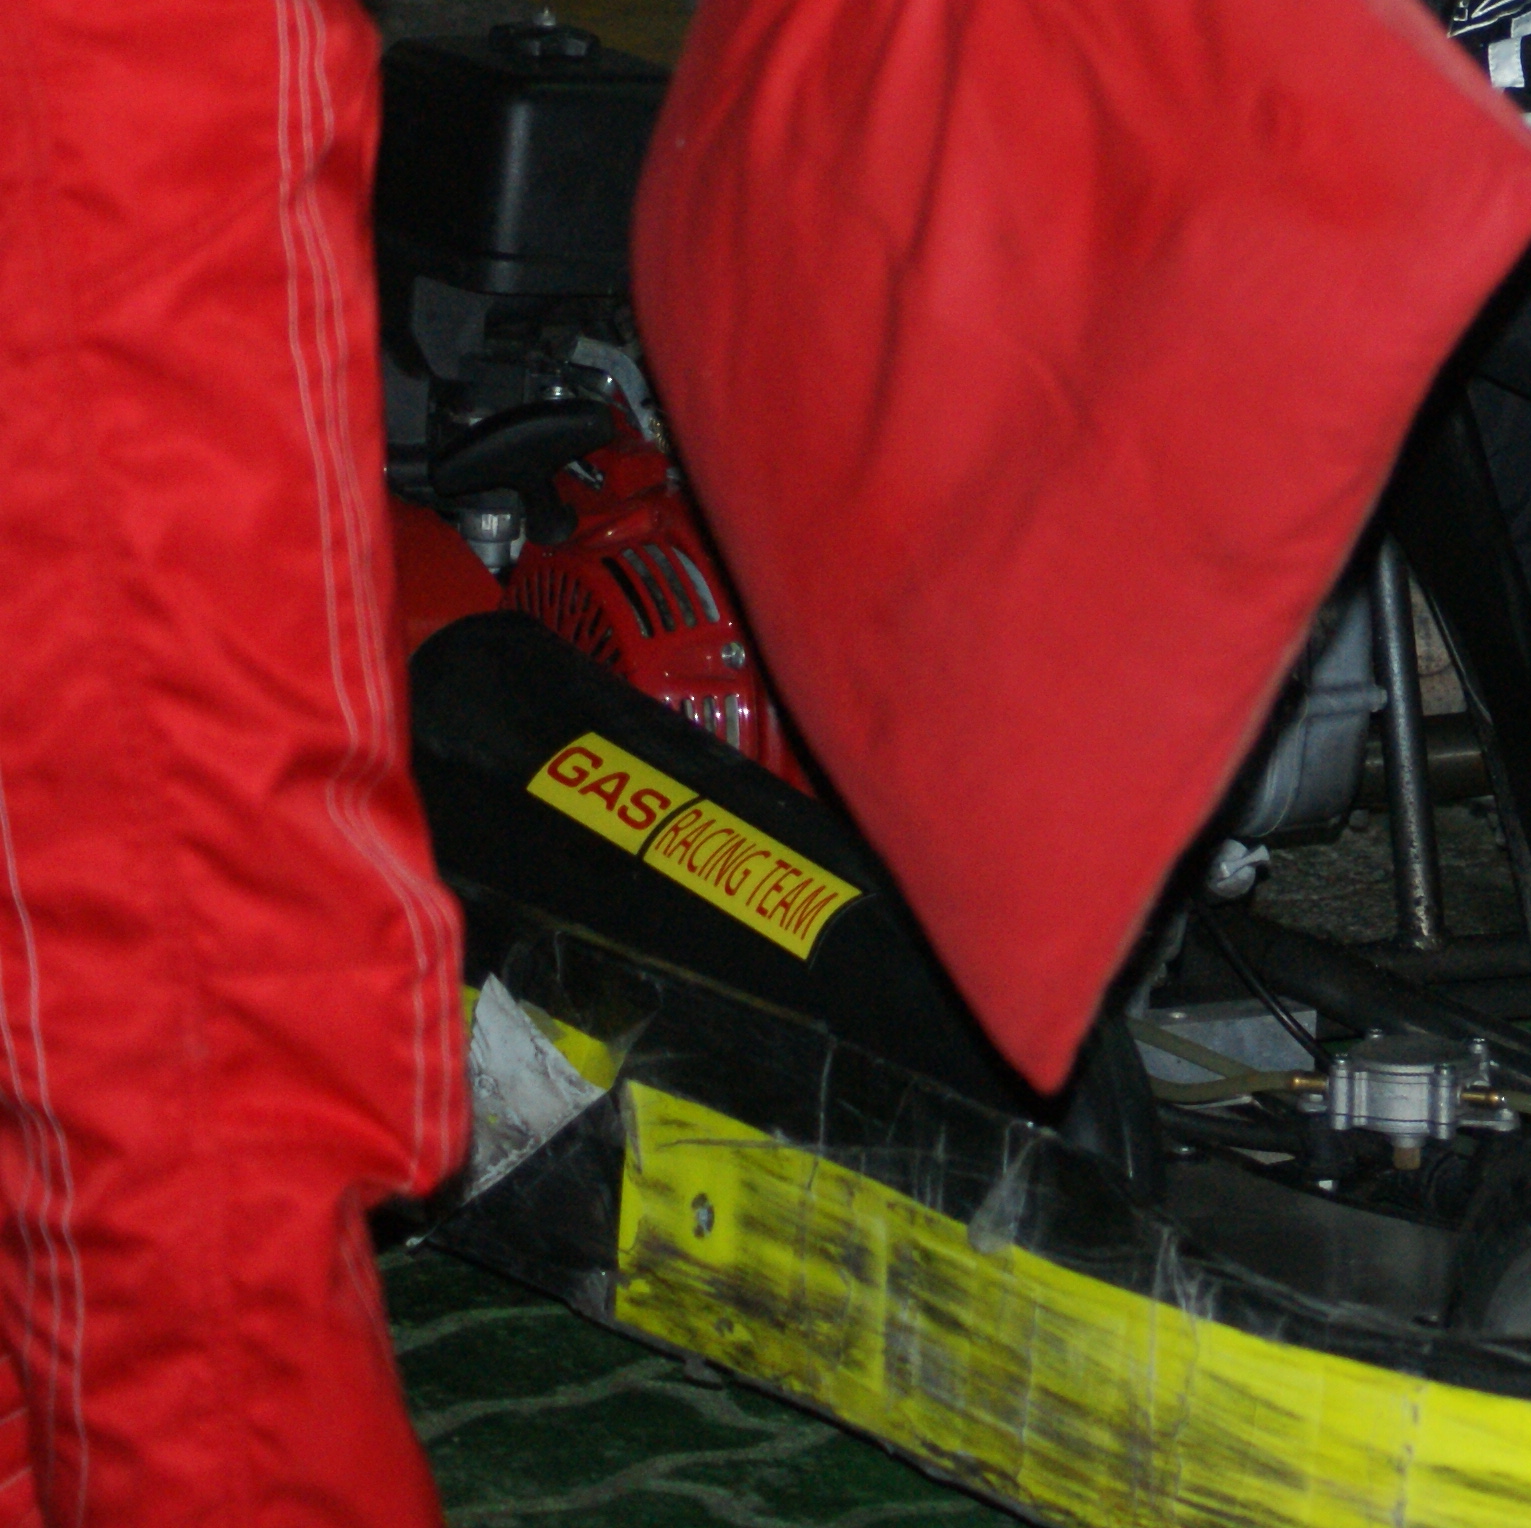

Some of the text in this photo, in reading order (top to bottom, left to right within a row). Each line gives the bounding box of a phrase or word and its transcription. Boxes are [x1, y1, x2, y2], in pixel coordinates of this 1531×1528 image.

[548, 746, 671, 829] GAS
[655, 809, 838, 940] RACING TEAM
